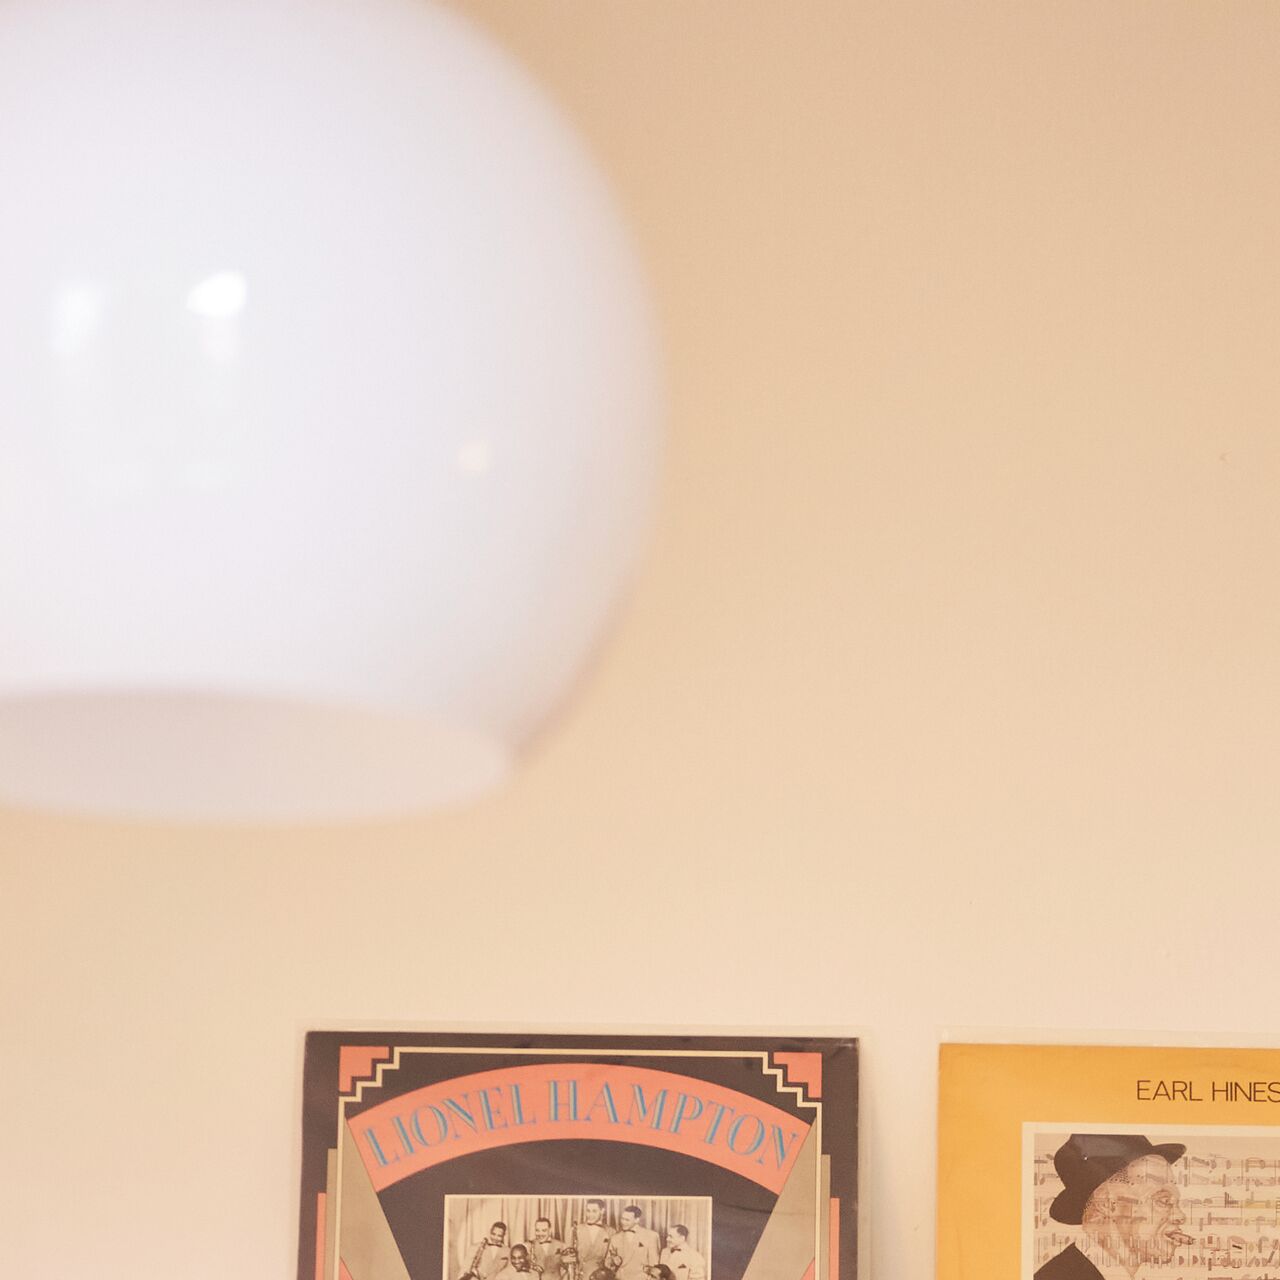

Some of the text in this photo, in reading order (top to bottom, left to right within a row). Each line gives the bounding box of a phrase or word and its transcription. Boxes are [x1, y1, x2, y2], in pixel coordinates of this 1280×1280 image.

[1136, 1079, 1203, 1101] EARL
[363, 1080, 799, 1169] LIONEL HAMPTON
